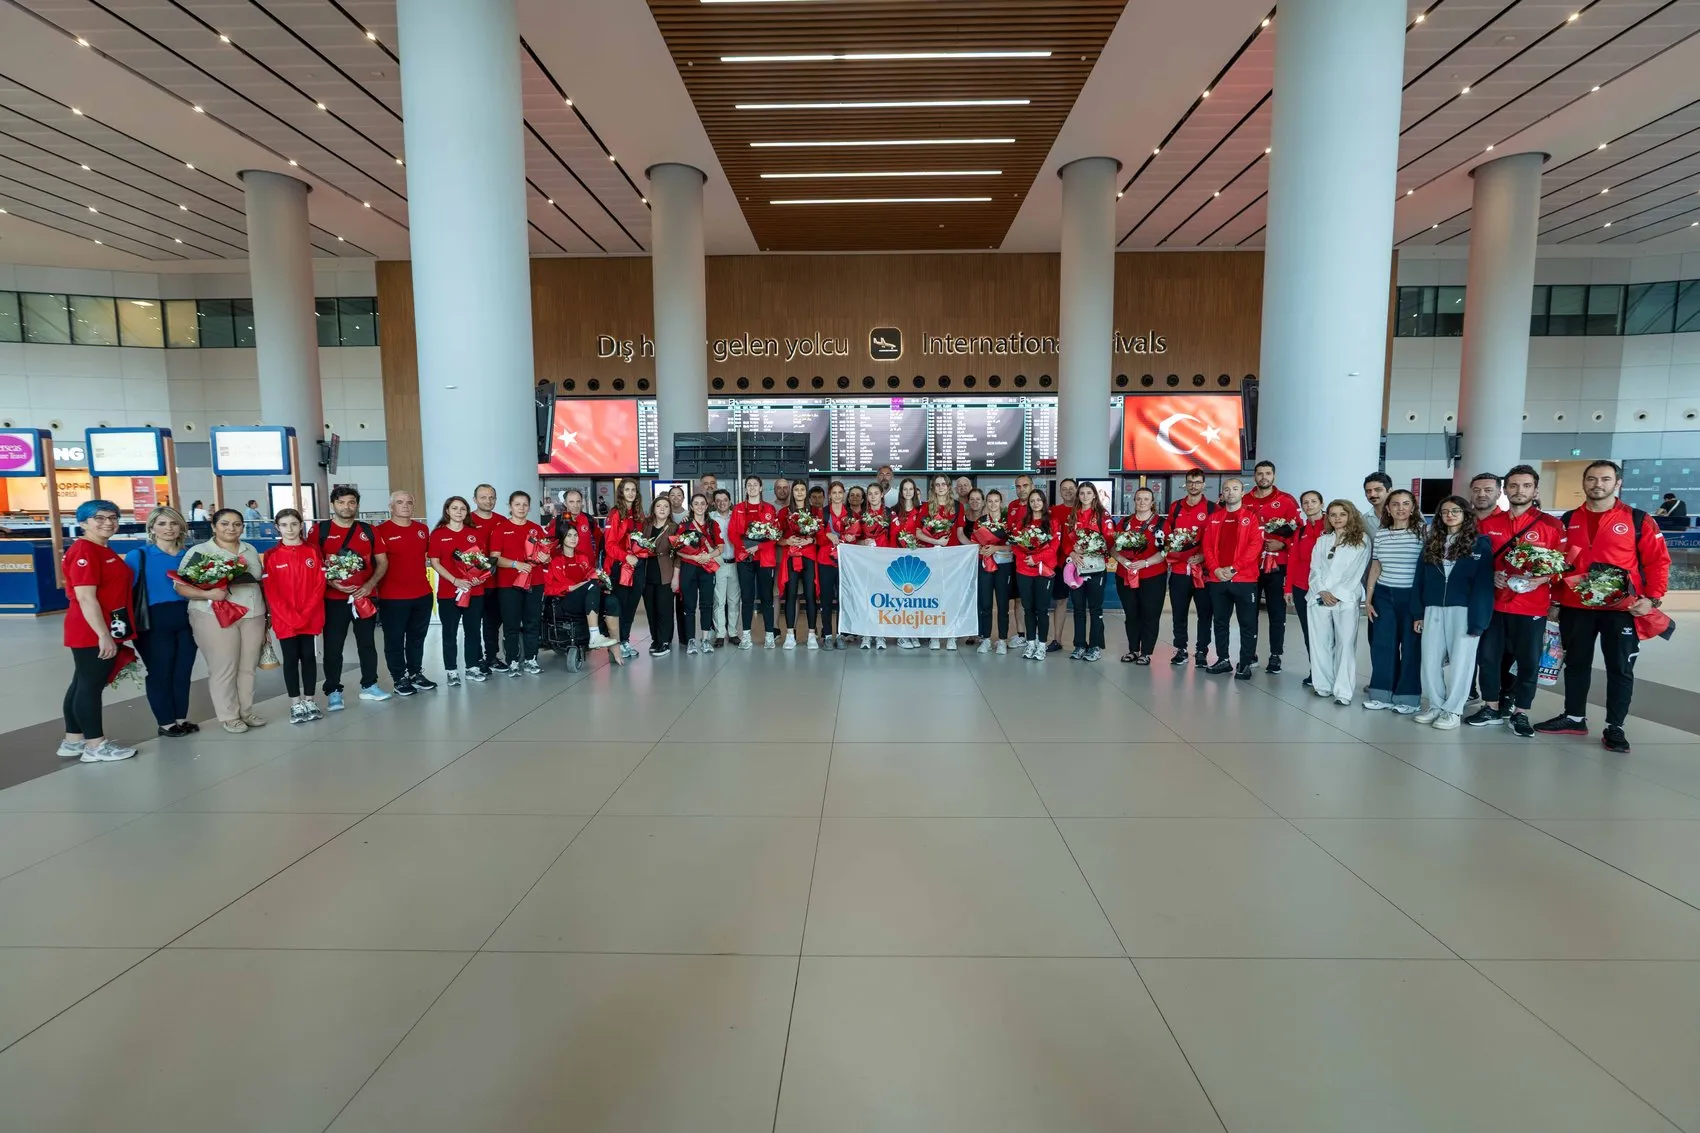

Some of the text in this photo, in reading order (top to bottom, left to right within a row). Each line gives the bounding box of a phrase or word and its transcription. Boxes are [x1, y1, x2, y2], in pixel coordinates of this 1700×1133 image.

[597, 334, 634, 362] Dış
[713, 332, 779, 362] gelen
[784, 332, 849, 362] yolcu
[923, 331, 1060, 356] Internation
[1112, 330, 1168, 355] ivals
[53, 447, 85, 461] NG
[870, 592, 939, 612] Okyanus
[878, 609, 946, 629] Kolejleri
